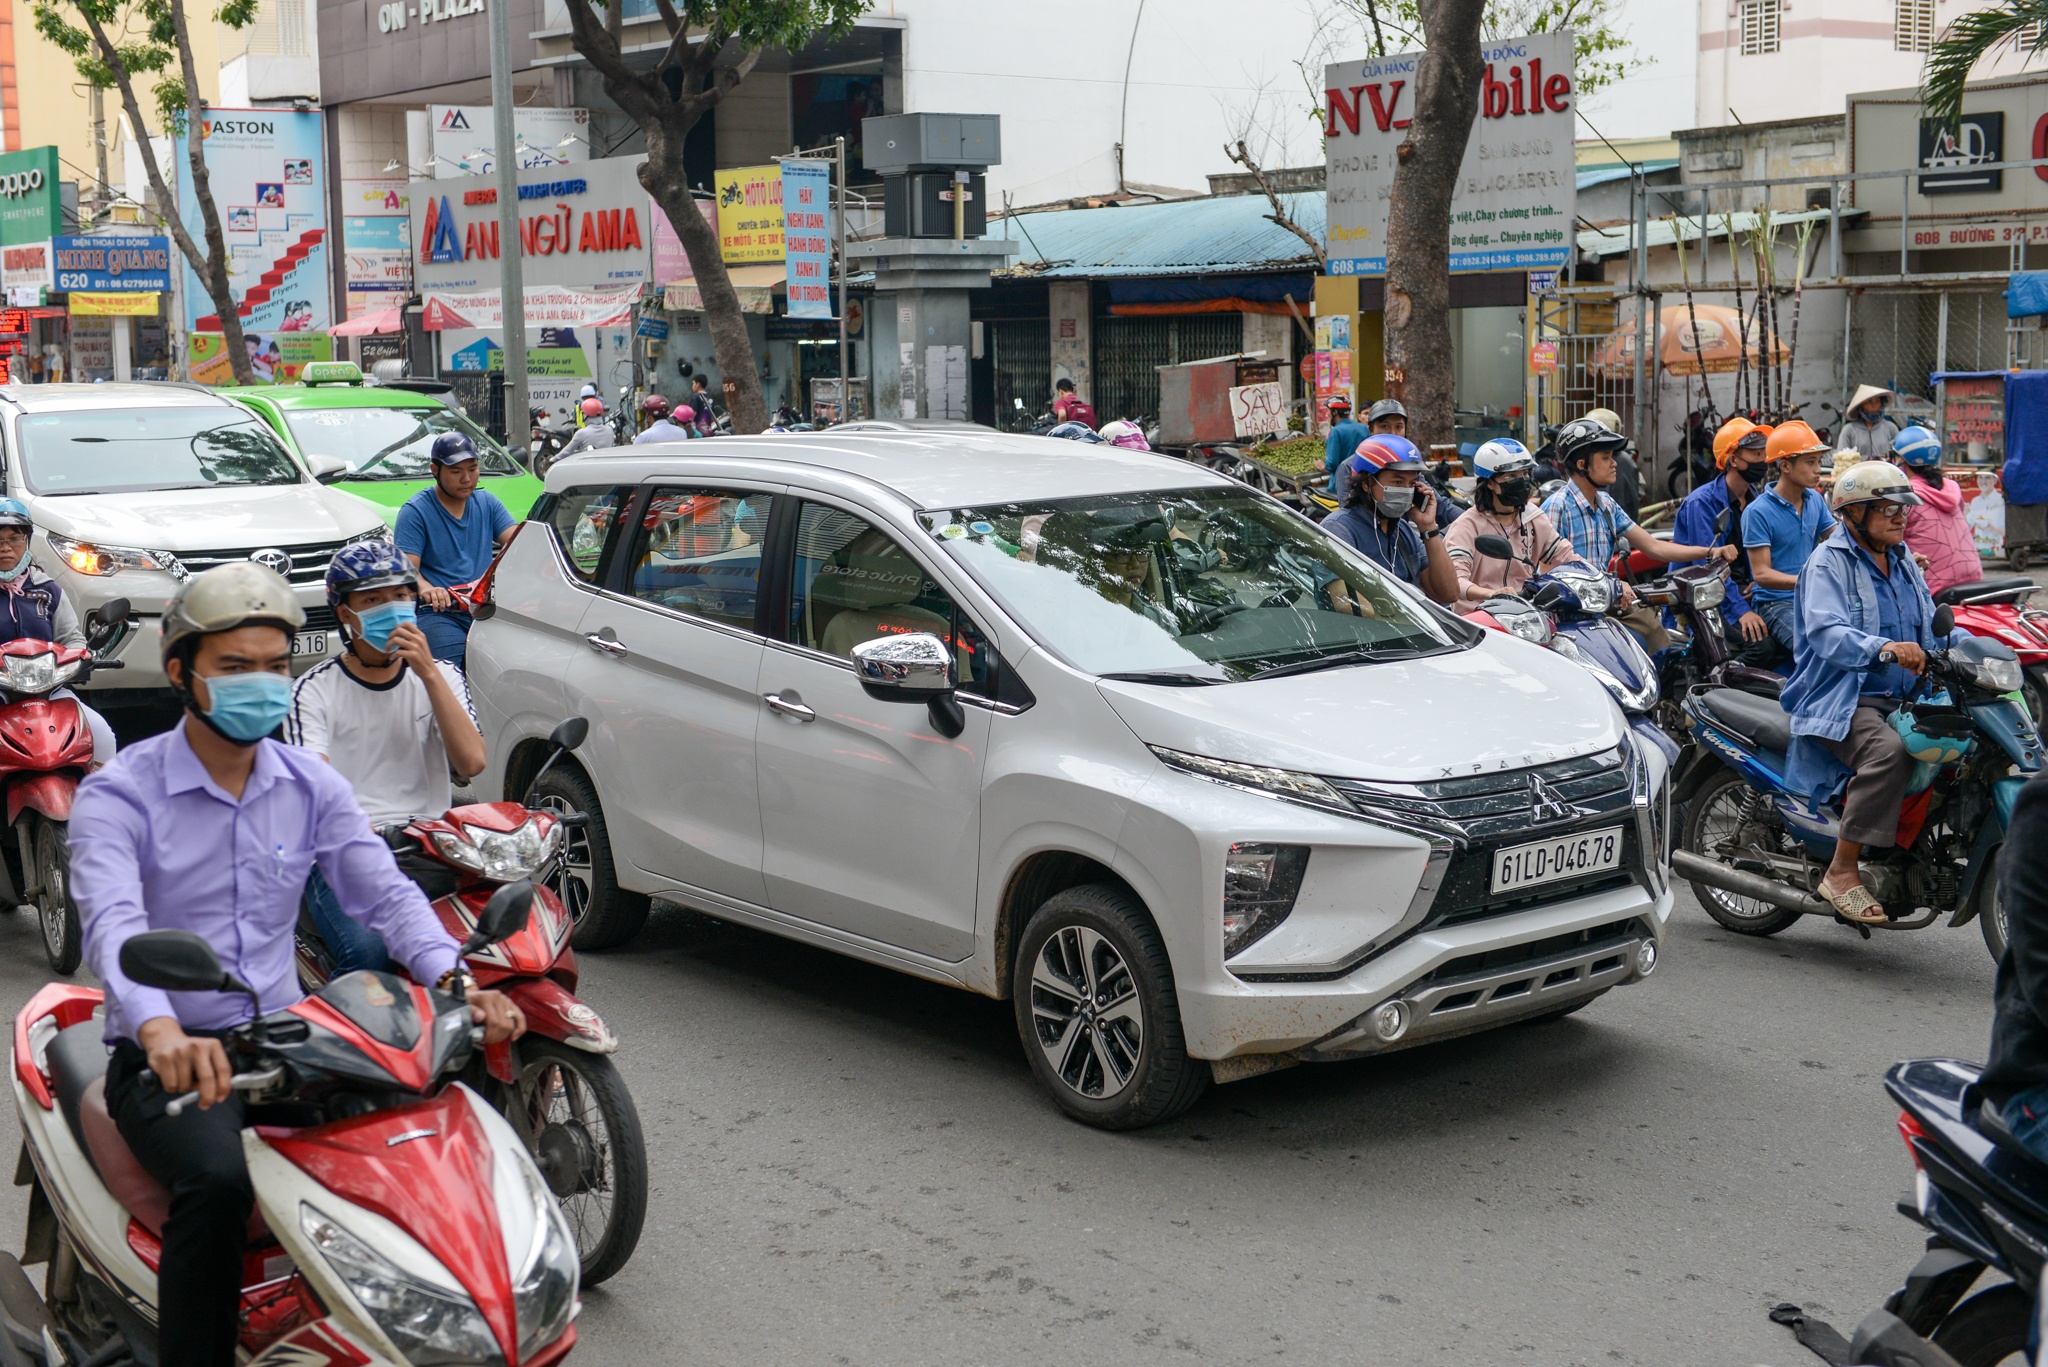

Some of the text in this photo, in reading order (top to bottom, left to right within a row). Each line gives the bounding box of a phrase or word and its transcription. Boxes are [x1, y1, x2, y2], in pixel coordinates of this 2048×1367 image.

[378, 0, 486, 33] ON PLAZA
[1385, 60, 1415, 74] HÀNG
[1493, 45, 1527, 62] ĐỘNG
[213, 121, 274, 135] ASTON
[551, 179, 587, 197] CENTER
[3, 206, 45, 221] SMARTPHONE
[1499, 208, 1530, 220] chương
[578, 207, 642, 253] AMA
[1500, 230, 1532, 244] Chuyên
[1534, 229, 1563, 243] nghiệp
[1914, 225, 1995, 245] 608 ĐƯỜNG
[72, 238, 149, 248] ĐIỆN THOẠI DI ĐỘNG
[309, 245, 320, 255] FCE
[57, 249, 168, 276] MINH QUANG
[297, 257, 311, 267] PET
[1332, 259, 1376, 274] 608 ĐƯỜNG
[60, 273, 88, 288] 620
[284, 270, 298, 281] KET
[272, 281, 299, 298] Flyers
[254, 298, 285, 314] Movers
[452, 296, 469, 308] CHÚC
[531, 295, 546, 305] KHAI
[574, 295, 578, 305] 2
[580, 294, 593, 305] CHI
[537, 308, 545, 320] VÀ
[546, 310, 559, 321] AMA
[362, 345, 399, 356] S2 Coffee
[93, 358, 105, 366] CAO
[537, 356, 560, 365] CHUẨN
[532, 389, 571, 400] 007 147
[1441, 742, 1600, 778] XPANDER
[1501, 834, 1615, 885] 61LD-046.78
